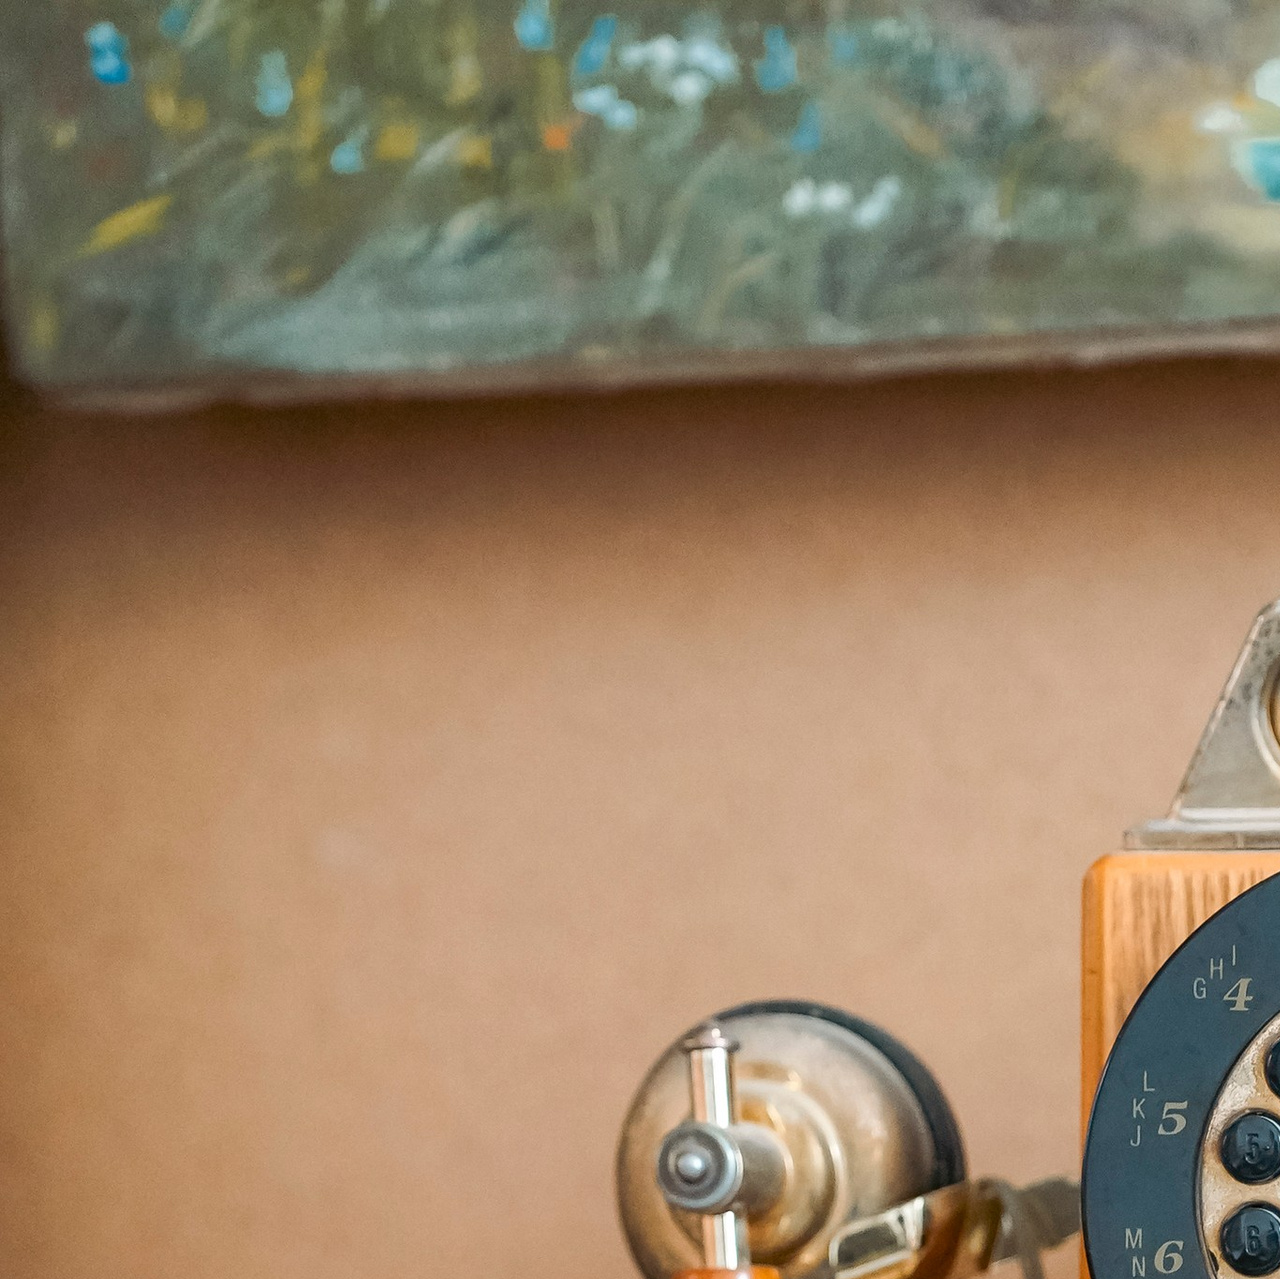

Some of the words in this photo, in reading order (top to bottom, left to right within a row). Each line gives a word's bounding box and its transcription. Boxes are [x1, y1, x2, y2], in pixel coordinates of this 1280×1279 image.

[1193, 944, 1238, 1000] GHI
[1223, 978, 1254, 1012] 4
[1157, 1101, 1188, 1135] 5
[1154, 1240, 1184, 1274] 6
